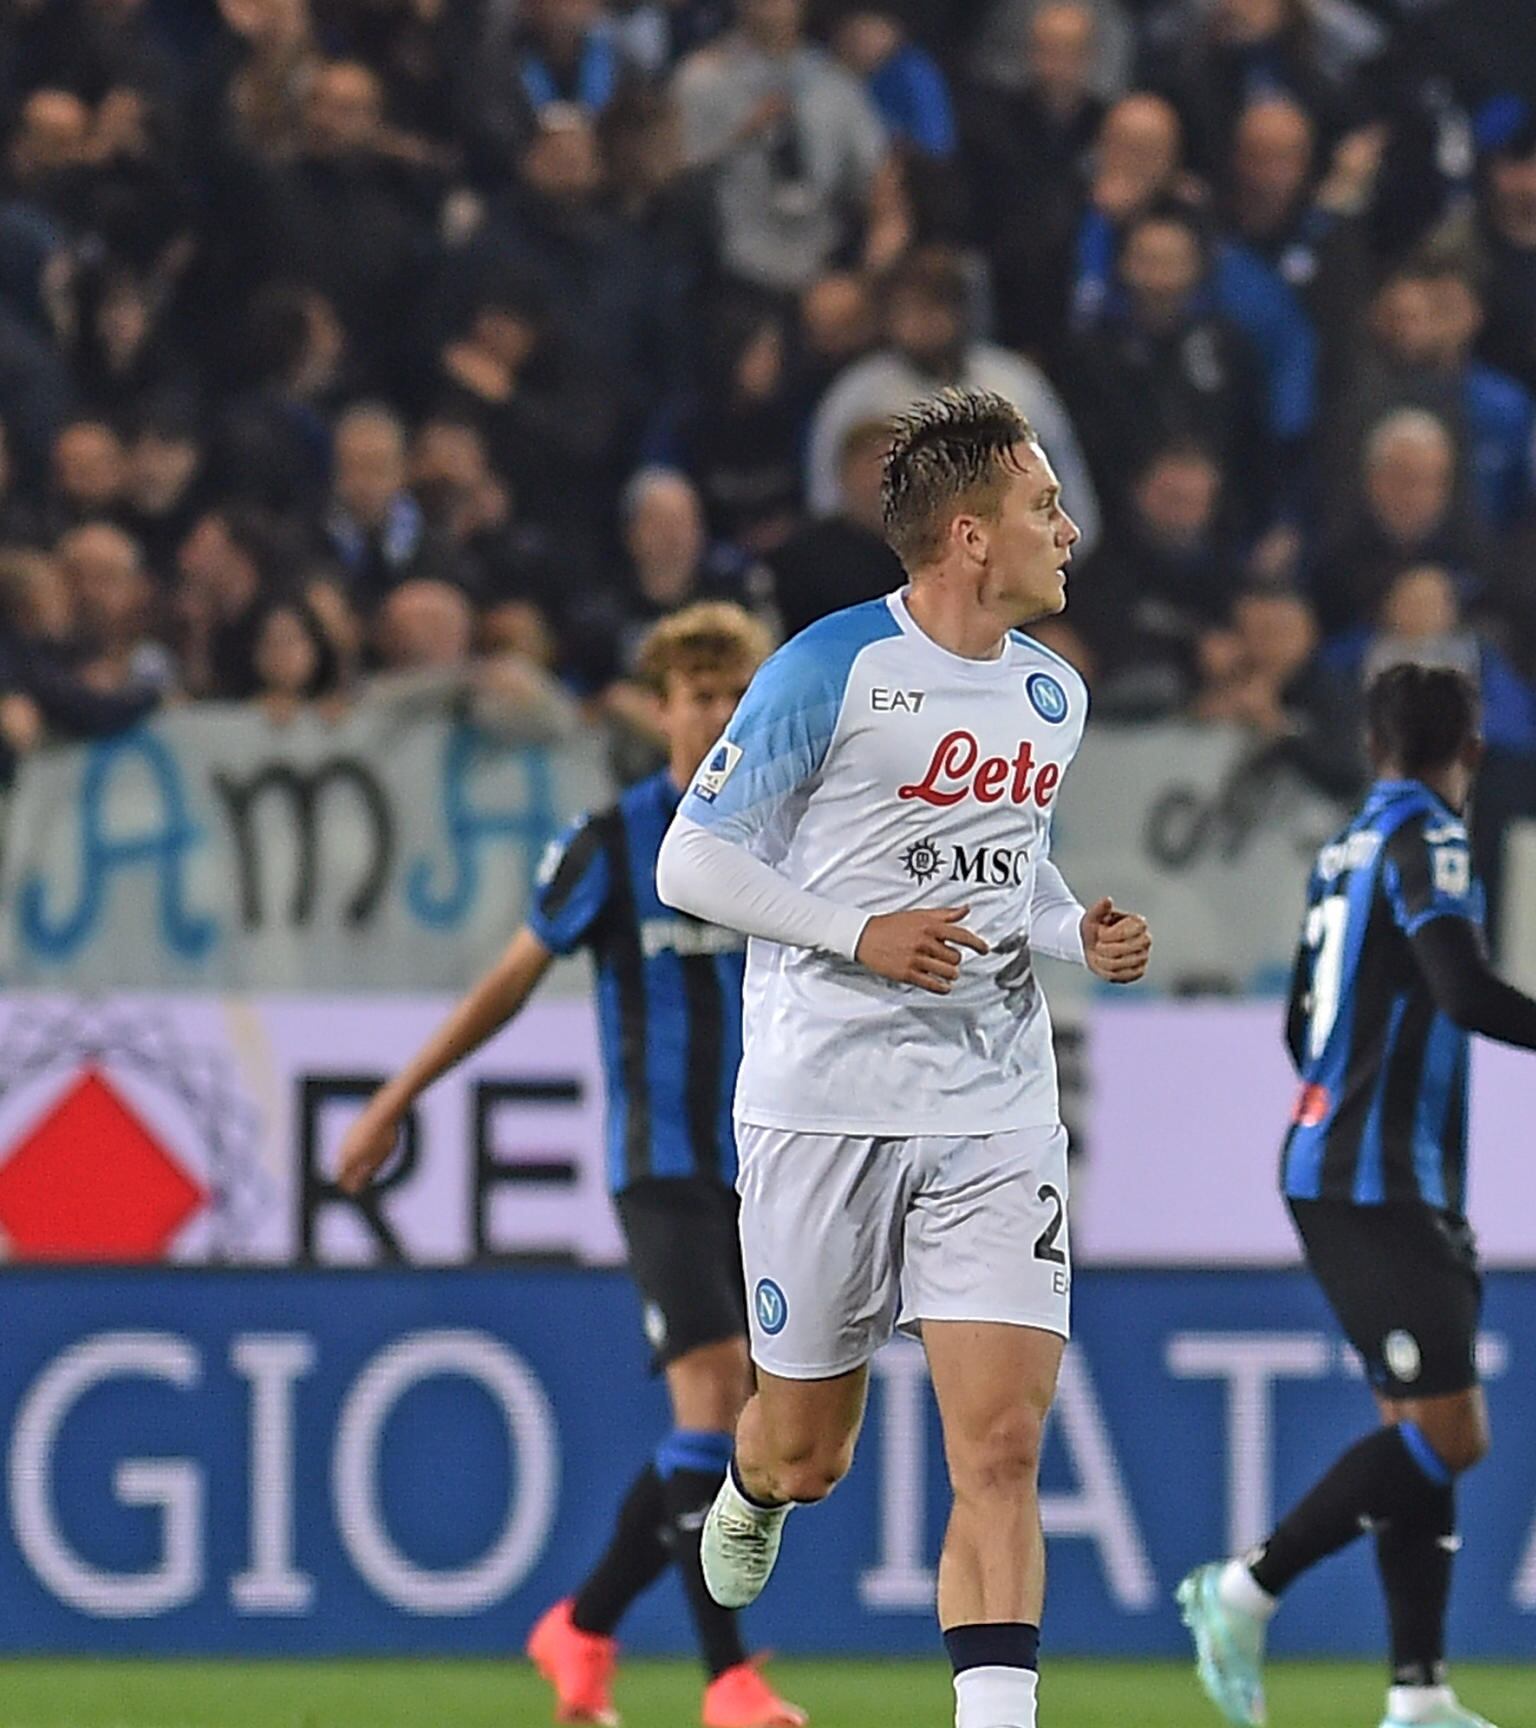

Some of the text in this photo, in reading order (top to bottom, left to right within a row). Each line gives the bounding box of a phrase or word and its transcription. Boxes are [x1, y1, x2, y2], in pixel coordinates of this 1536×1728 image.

[871, 687, 926, 714] EA7
[898, 730, 1060, 808] Lete
[948, 844, 1030, 886] MSC
[1032, 1183, 1066, 1266] 2
[9, 1329, 564, 1618] GIO
